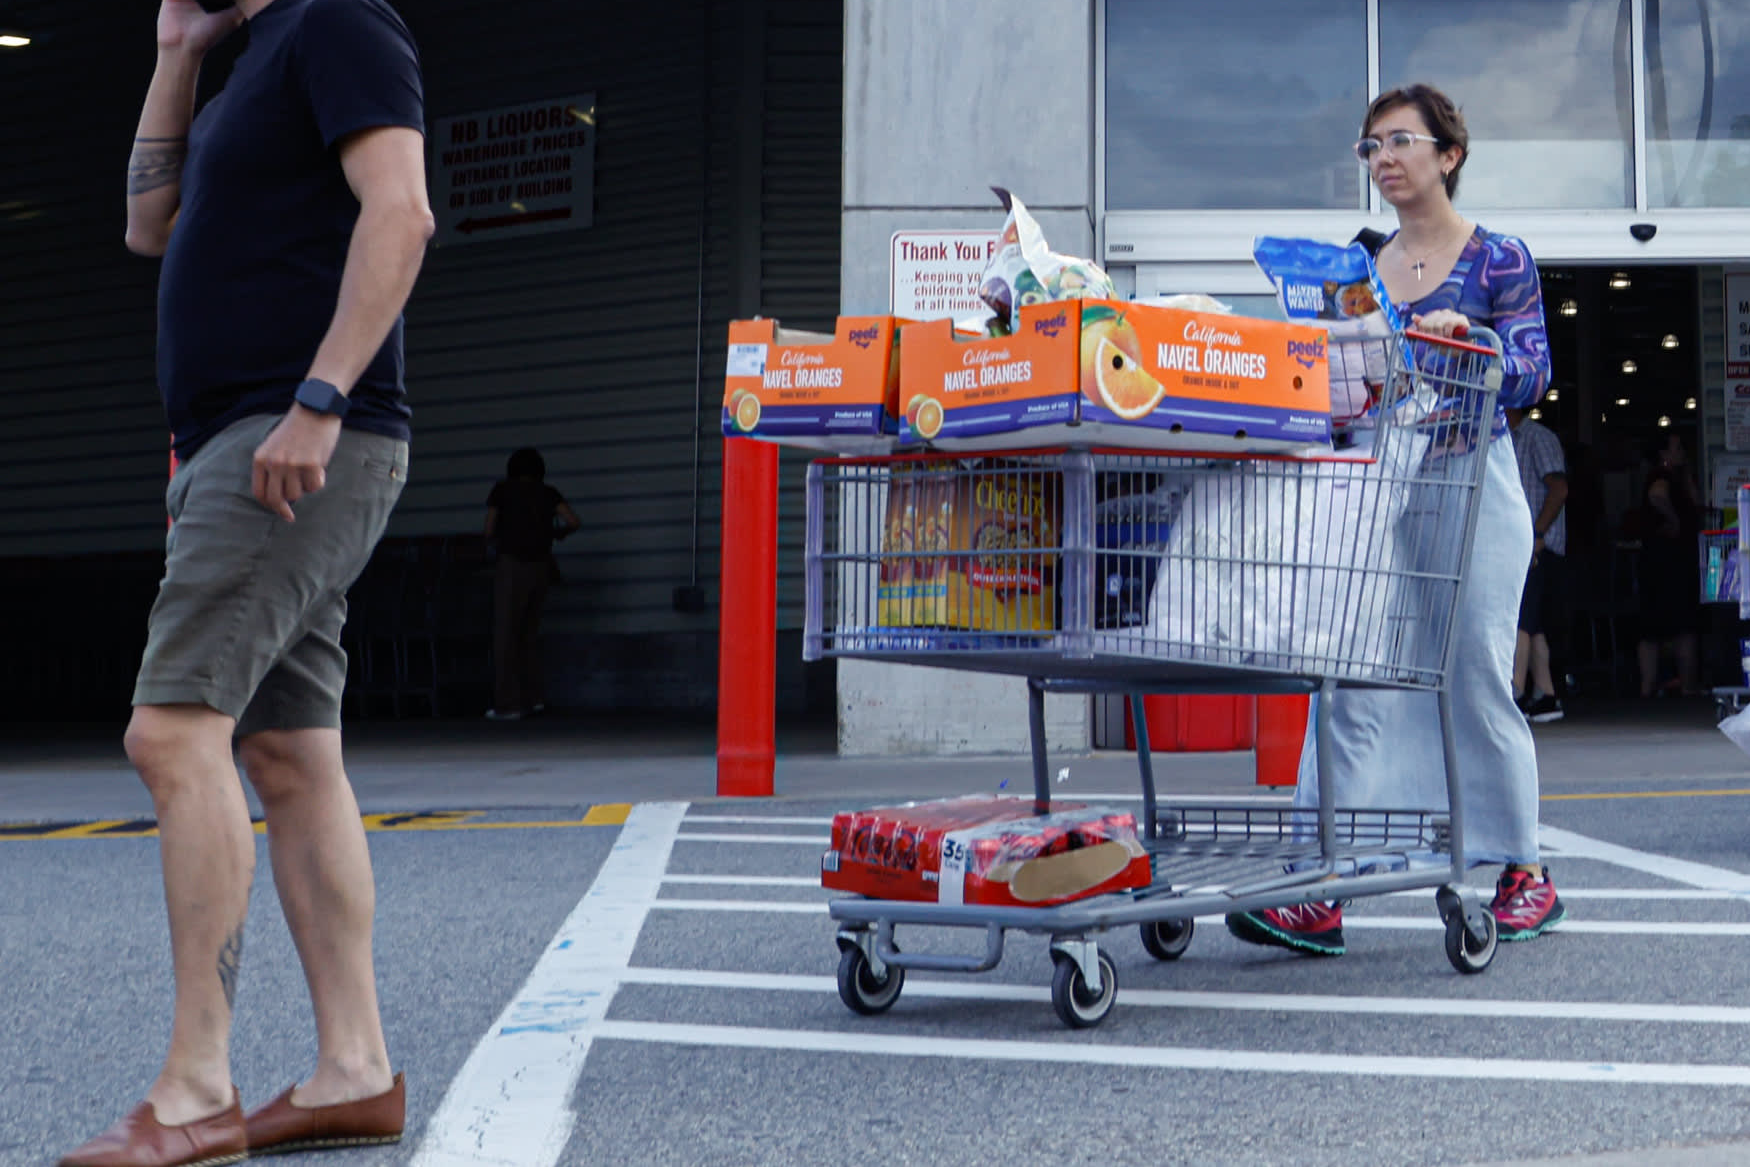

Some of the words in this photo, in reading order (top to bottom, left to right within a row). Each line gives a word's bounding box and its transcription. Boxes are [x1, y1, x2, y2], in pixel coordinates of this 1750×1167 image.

[487, 105, 577, 139] LIQUORS
[442, 139, 526, 167] WAREHOUSE
[533, 131, 585, 152] PRICES
[453, 164, 509, 187] ENTRANCE
[514, 155, 571, 179] LOCATION
[517, 177, 572, 199] BUILDING
[901, 242, 948, 261] Thank
[954, 242, 980, 260] You
[914, 285, 963, 296] children
[914, 300, 925, 310] at
[929, 299, 944, 310] all
[1289, 296, 1325, 311] WANTED
[1184, 320, 1243, 347] California
[963, 348, 1011, 368] California
[1287, 338, 1325, 358] peelz
[780, 350, 825, 369] California
[1158, 342, 1200, 373] NAVEL
[1204, 348, 1267, 380] ORANGES
[763, 369, 793, 389] NAVEL
[795, 368, 842, 388] ORANGES
[944, 369, 978, 392] NAVEL
[980, 361, 1032, 388] ORANGES
